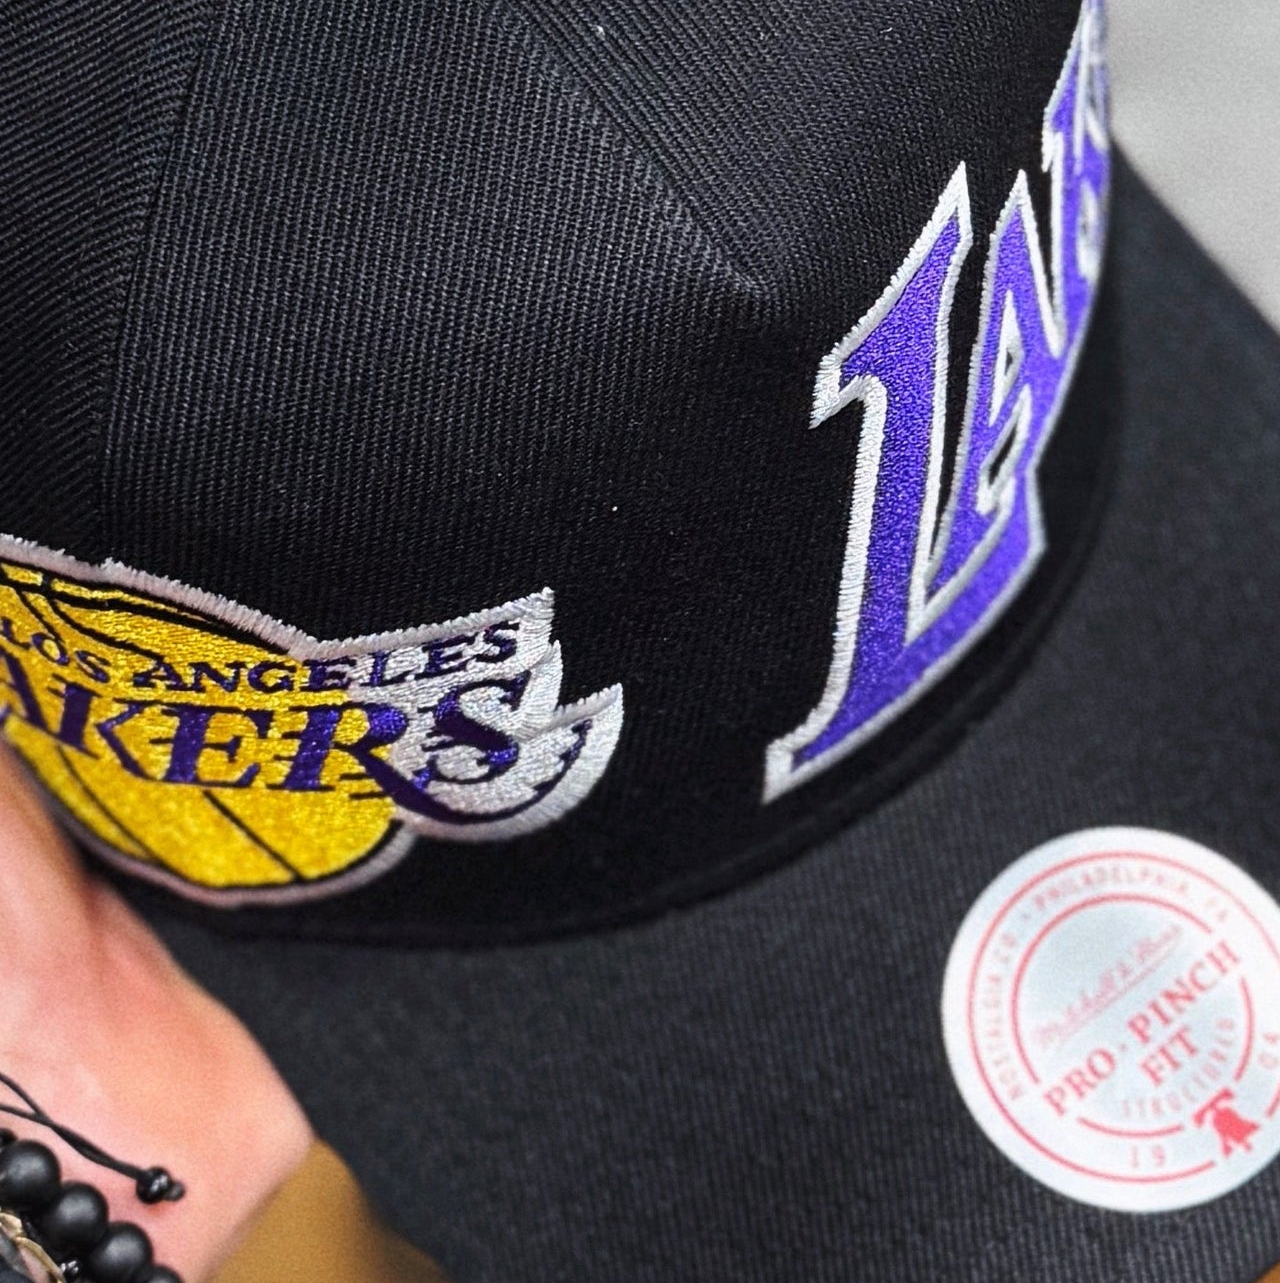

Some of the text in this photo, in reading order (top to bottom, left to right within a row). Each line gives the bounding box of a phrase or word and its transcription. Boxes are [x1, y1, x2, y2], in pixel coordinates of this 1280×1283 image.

[0, 615, 521, 695] LOS ANGELES
[1042, 1047, 1117, 1116] PRO
[1126, 938, 1240, 1044] PINCH
[1138, 1022, 1200, 1088] FIT
